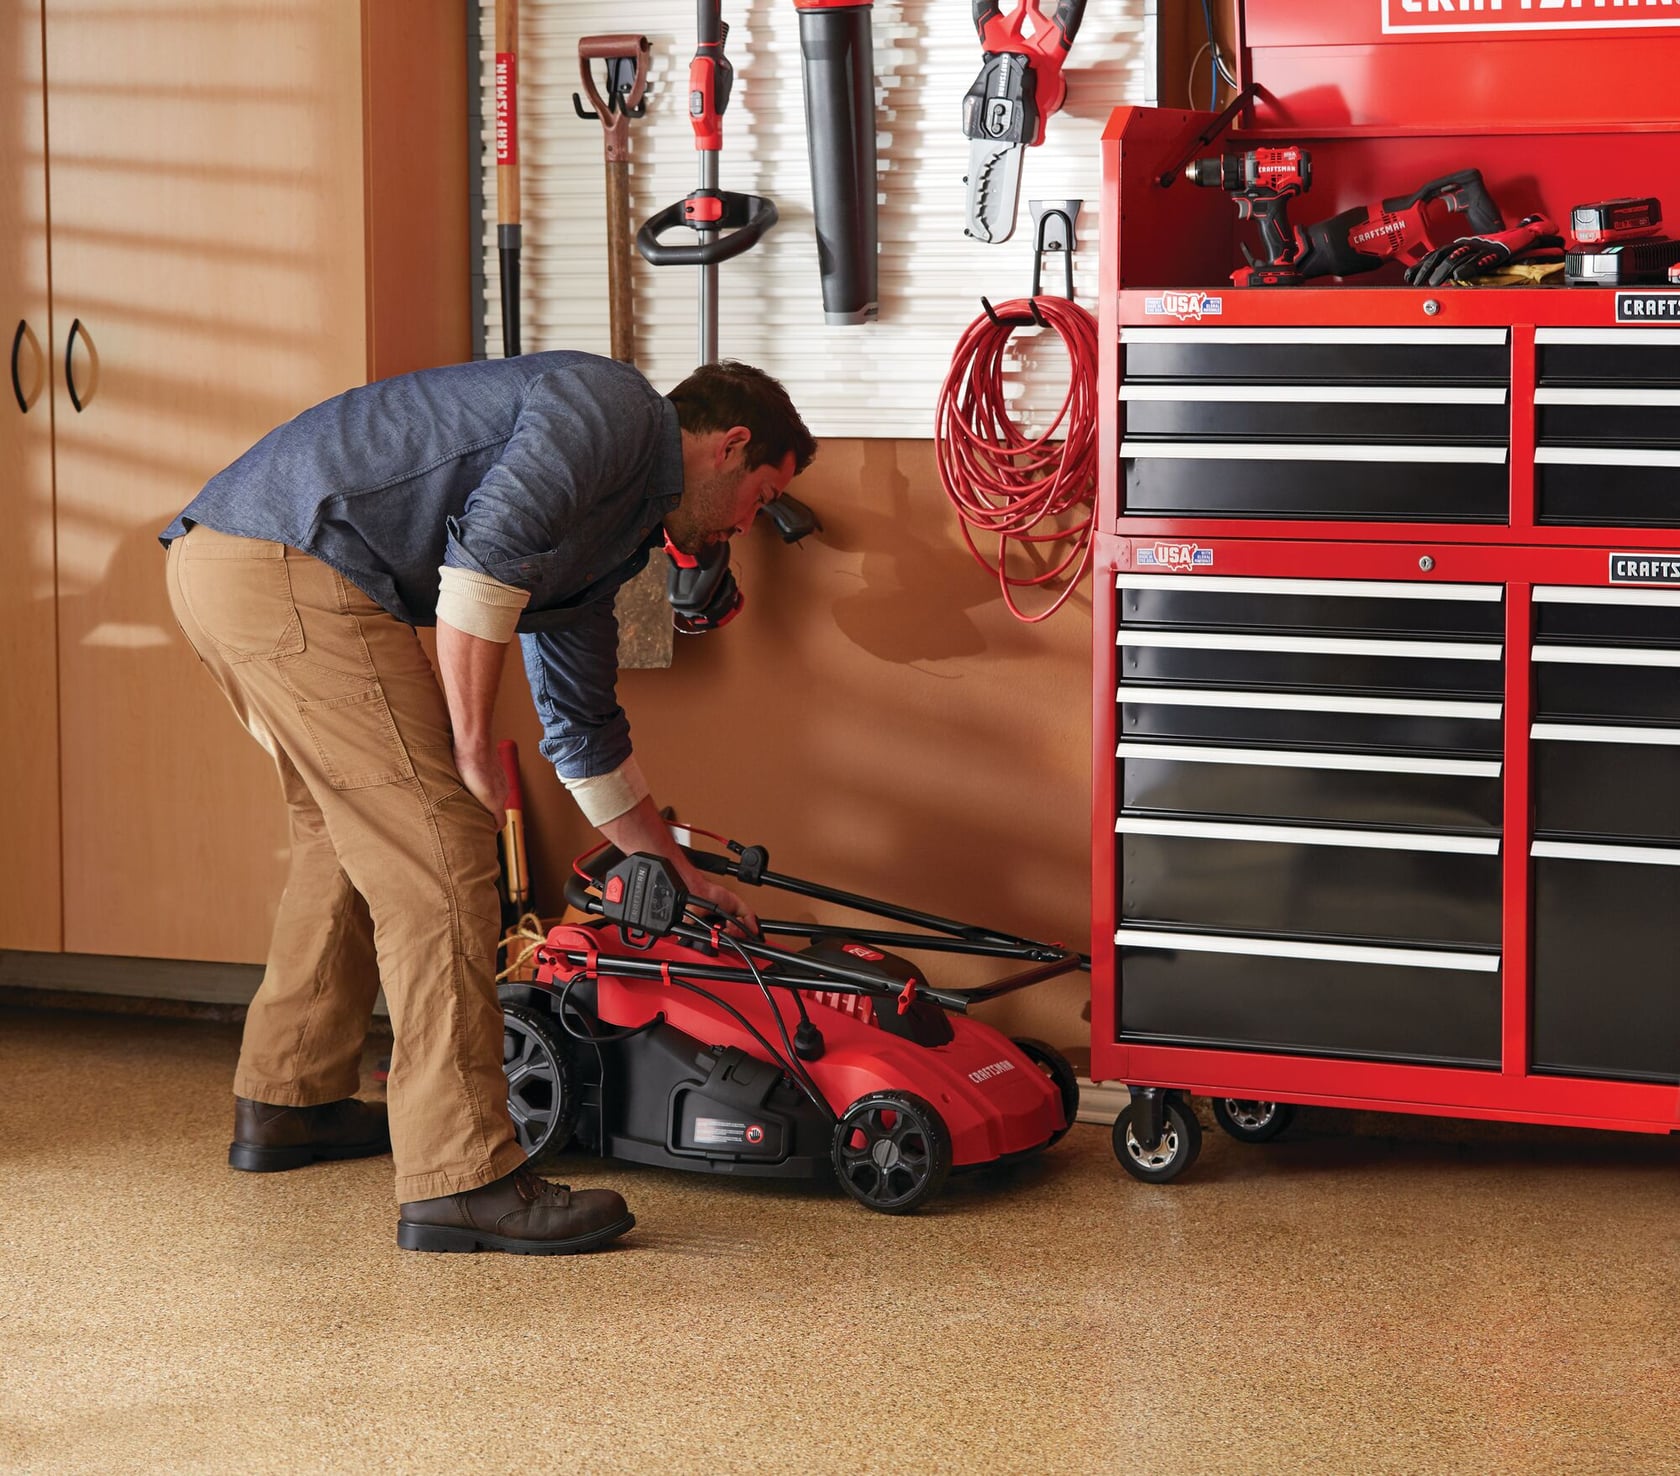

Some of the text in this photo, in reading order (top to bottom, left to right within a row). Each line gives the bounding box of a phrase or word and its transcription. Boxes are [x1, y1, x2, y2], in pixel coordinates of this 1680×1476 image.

[1258, 165, 1296, 173] CRAFTSMAN
[1353, 220, 1406, 244] CRAFTSMAN
[1166, 296, 1200, 313] USA
[1158, 546, 1191, 563] USA
[968, 1060, 1015, 1084] CRAFTSMAN
